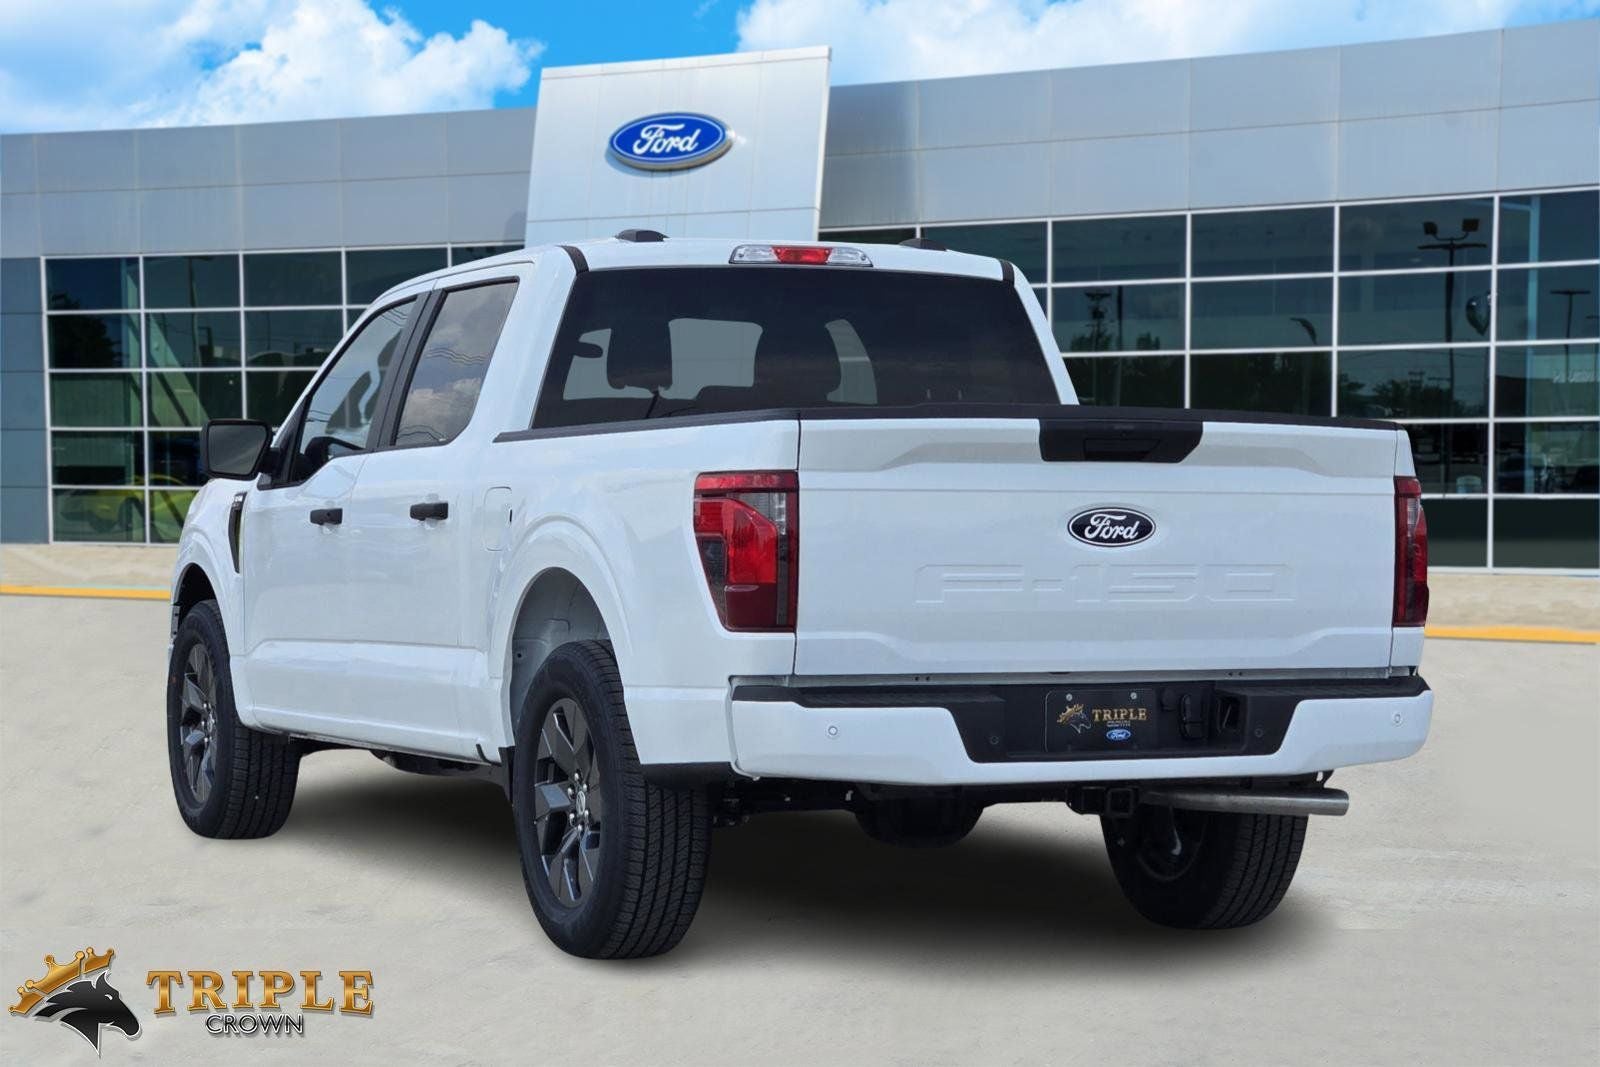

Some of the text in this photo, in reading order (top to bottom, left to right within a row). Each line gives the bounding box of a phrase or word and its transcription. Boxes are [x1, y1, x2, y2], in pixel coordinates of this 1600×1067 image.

[632, 123, 701, 155] Ford
[1084, 514, 1139, 540] Ford
[915, 563, 1297, 604] F-150
[1092, 708, 1147, 721] TRIPLE
